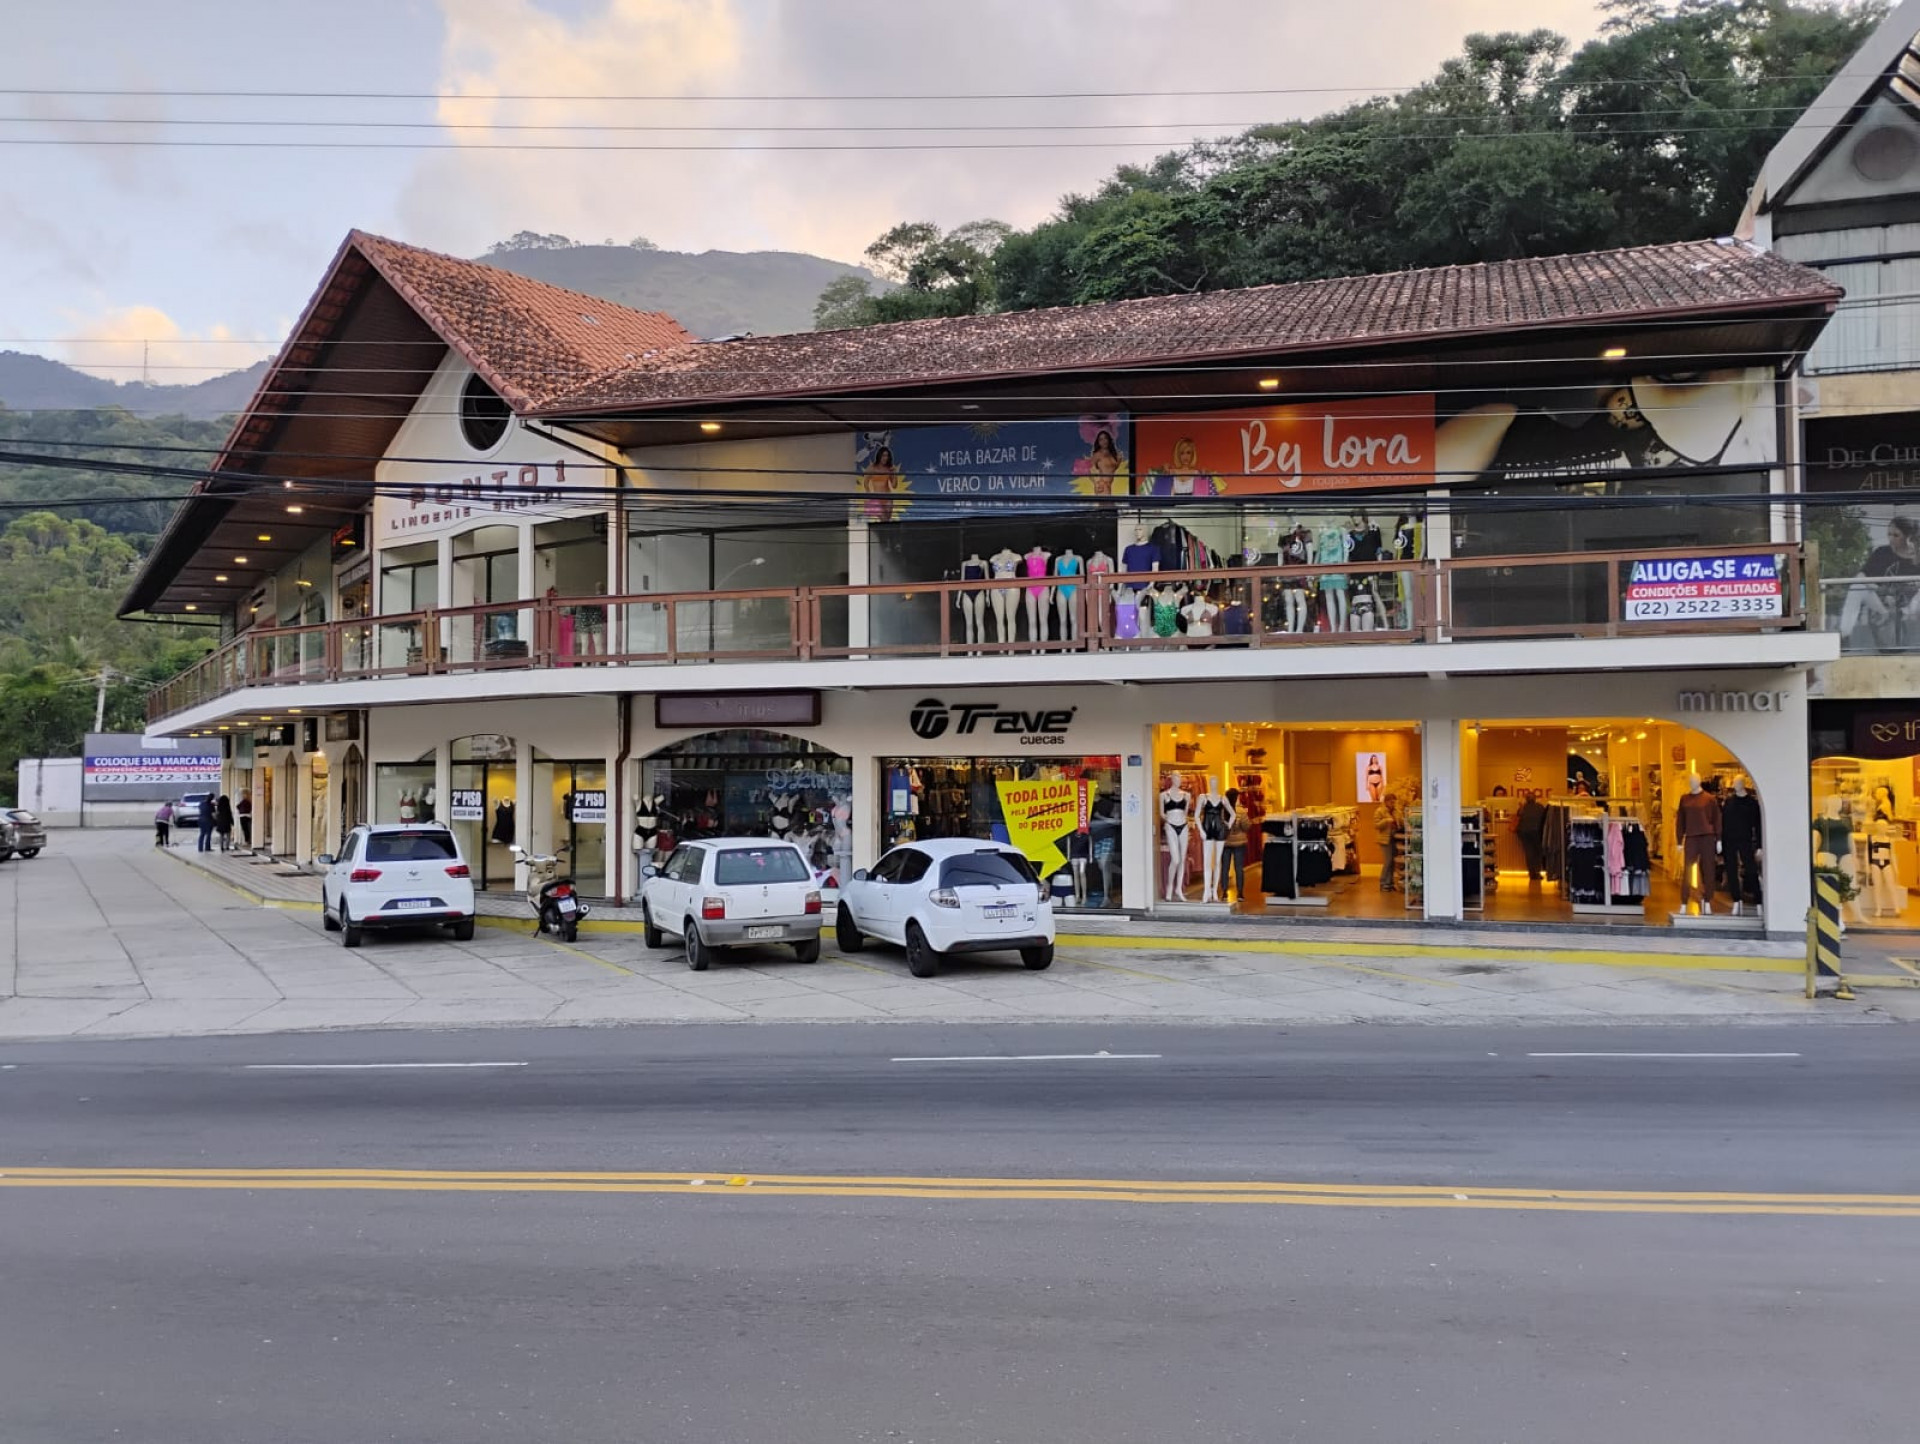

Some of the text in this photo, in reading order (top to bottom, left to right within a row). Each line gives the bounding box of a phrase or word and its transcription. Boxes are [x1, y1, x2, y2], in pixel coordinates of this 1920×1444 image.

[939, 445, 1038, 467] MEGA BAZAR DE
[1240, 420, 1302, 488] By
[988, 475, 1004, 490] DA
[1633, 559, 1736, 582] ALUGA-SE
[1632, 582, 1776, 599] CONDIÇÕES FACILITADAS
[1634, 598, 1775, 616] (22) 2522-3335
[1678, 684, 1790, 712] mimar
[1019, 735, 1065, 745] cuecas
[94, 757, 140, 766] COLOQUE
[142, 757, 162, 766] SUA
[163, 757, 198, 766] MARCA
[95, 775, 128, 783] (22)
[462, 791, 482, 805] PISO
[585, 793, 605, 806] PISO
[1006, 784, 1071, 804] TODA LOJA
[1028, 801, 1075, 817] METADE
[1031, 818, 1063, 831] PREÇO
